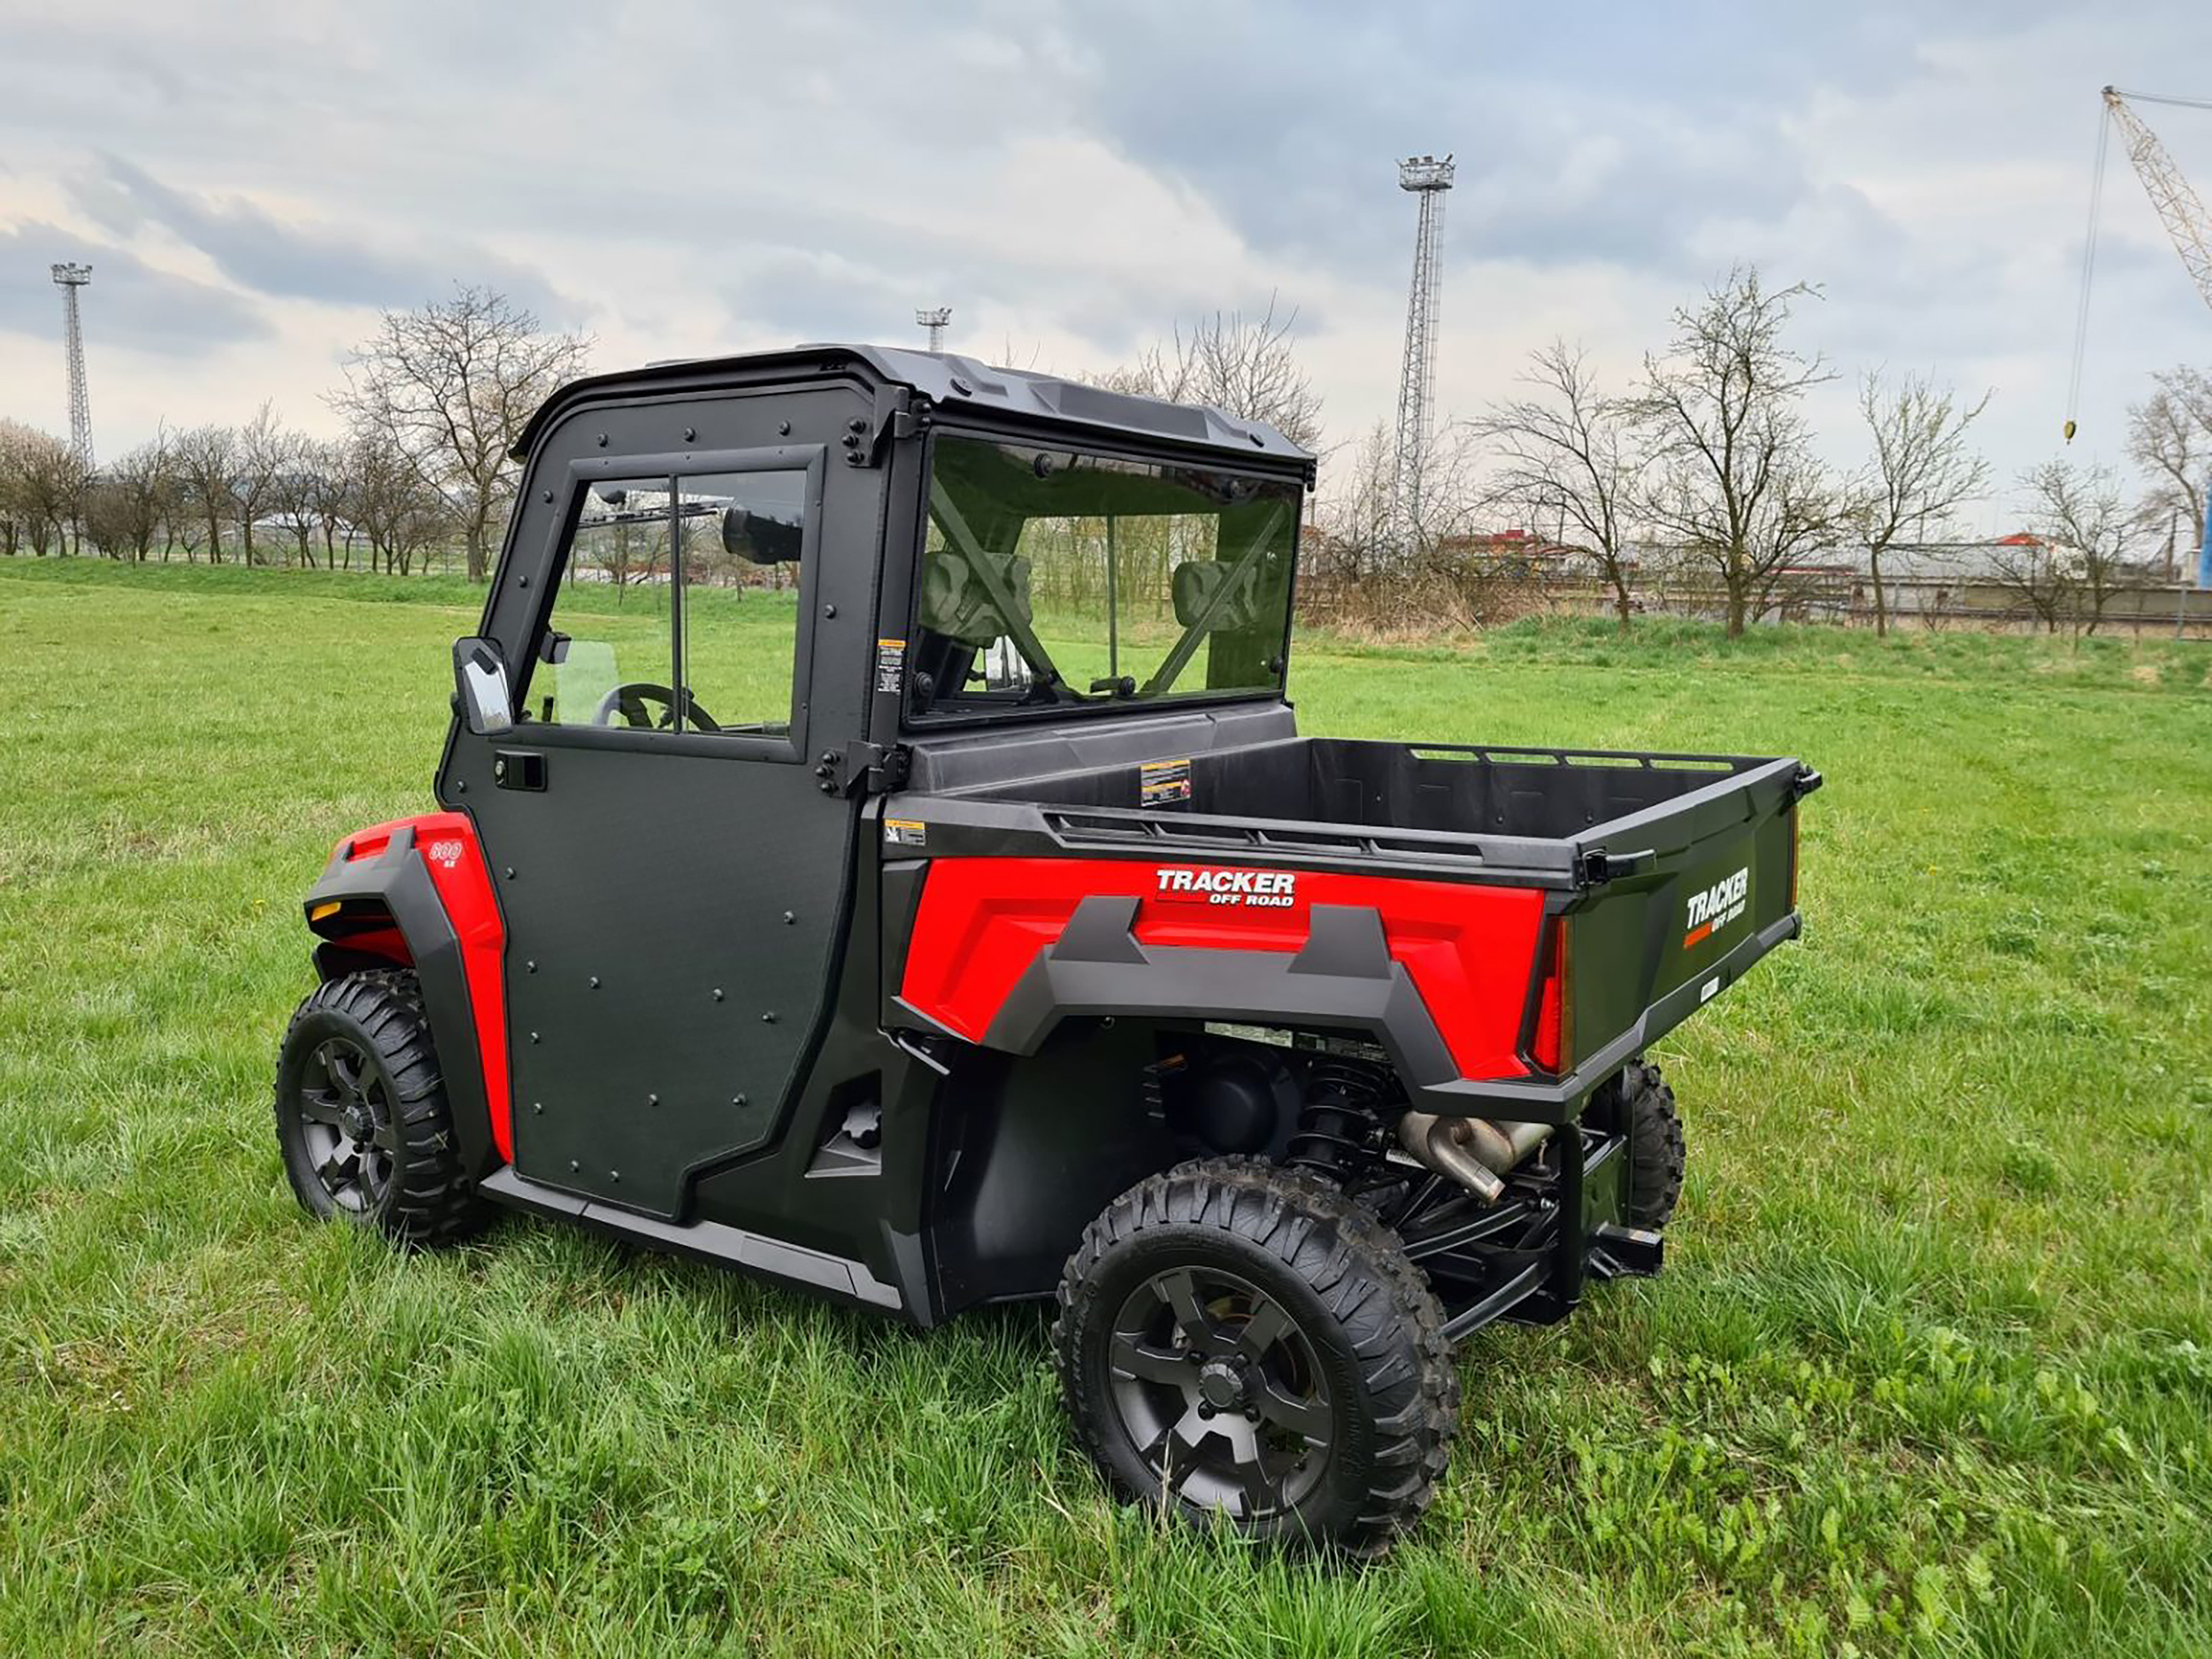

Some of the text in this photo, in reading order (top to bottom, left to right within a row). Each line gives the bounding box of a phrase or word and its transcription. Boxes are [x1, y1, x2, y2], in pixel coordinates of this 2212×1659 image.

[1156, 869, 1295, 894] TRACKER
[1210, 893, 1294, 907] OFF ROAD
[1687, 866, 1748, 929] TRACKER
